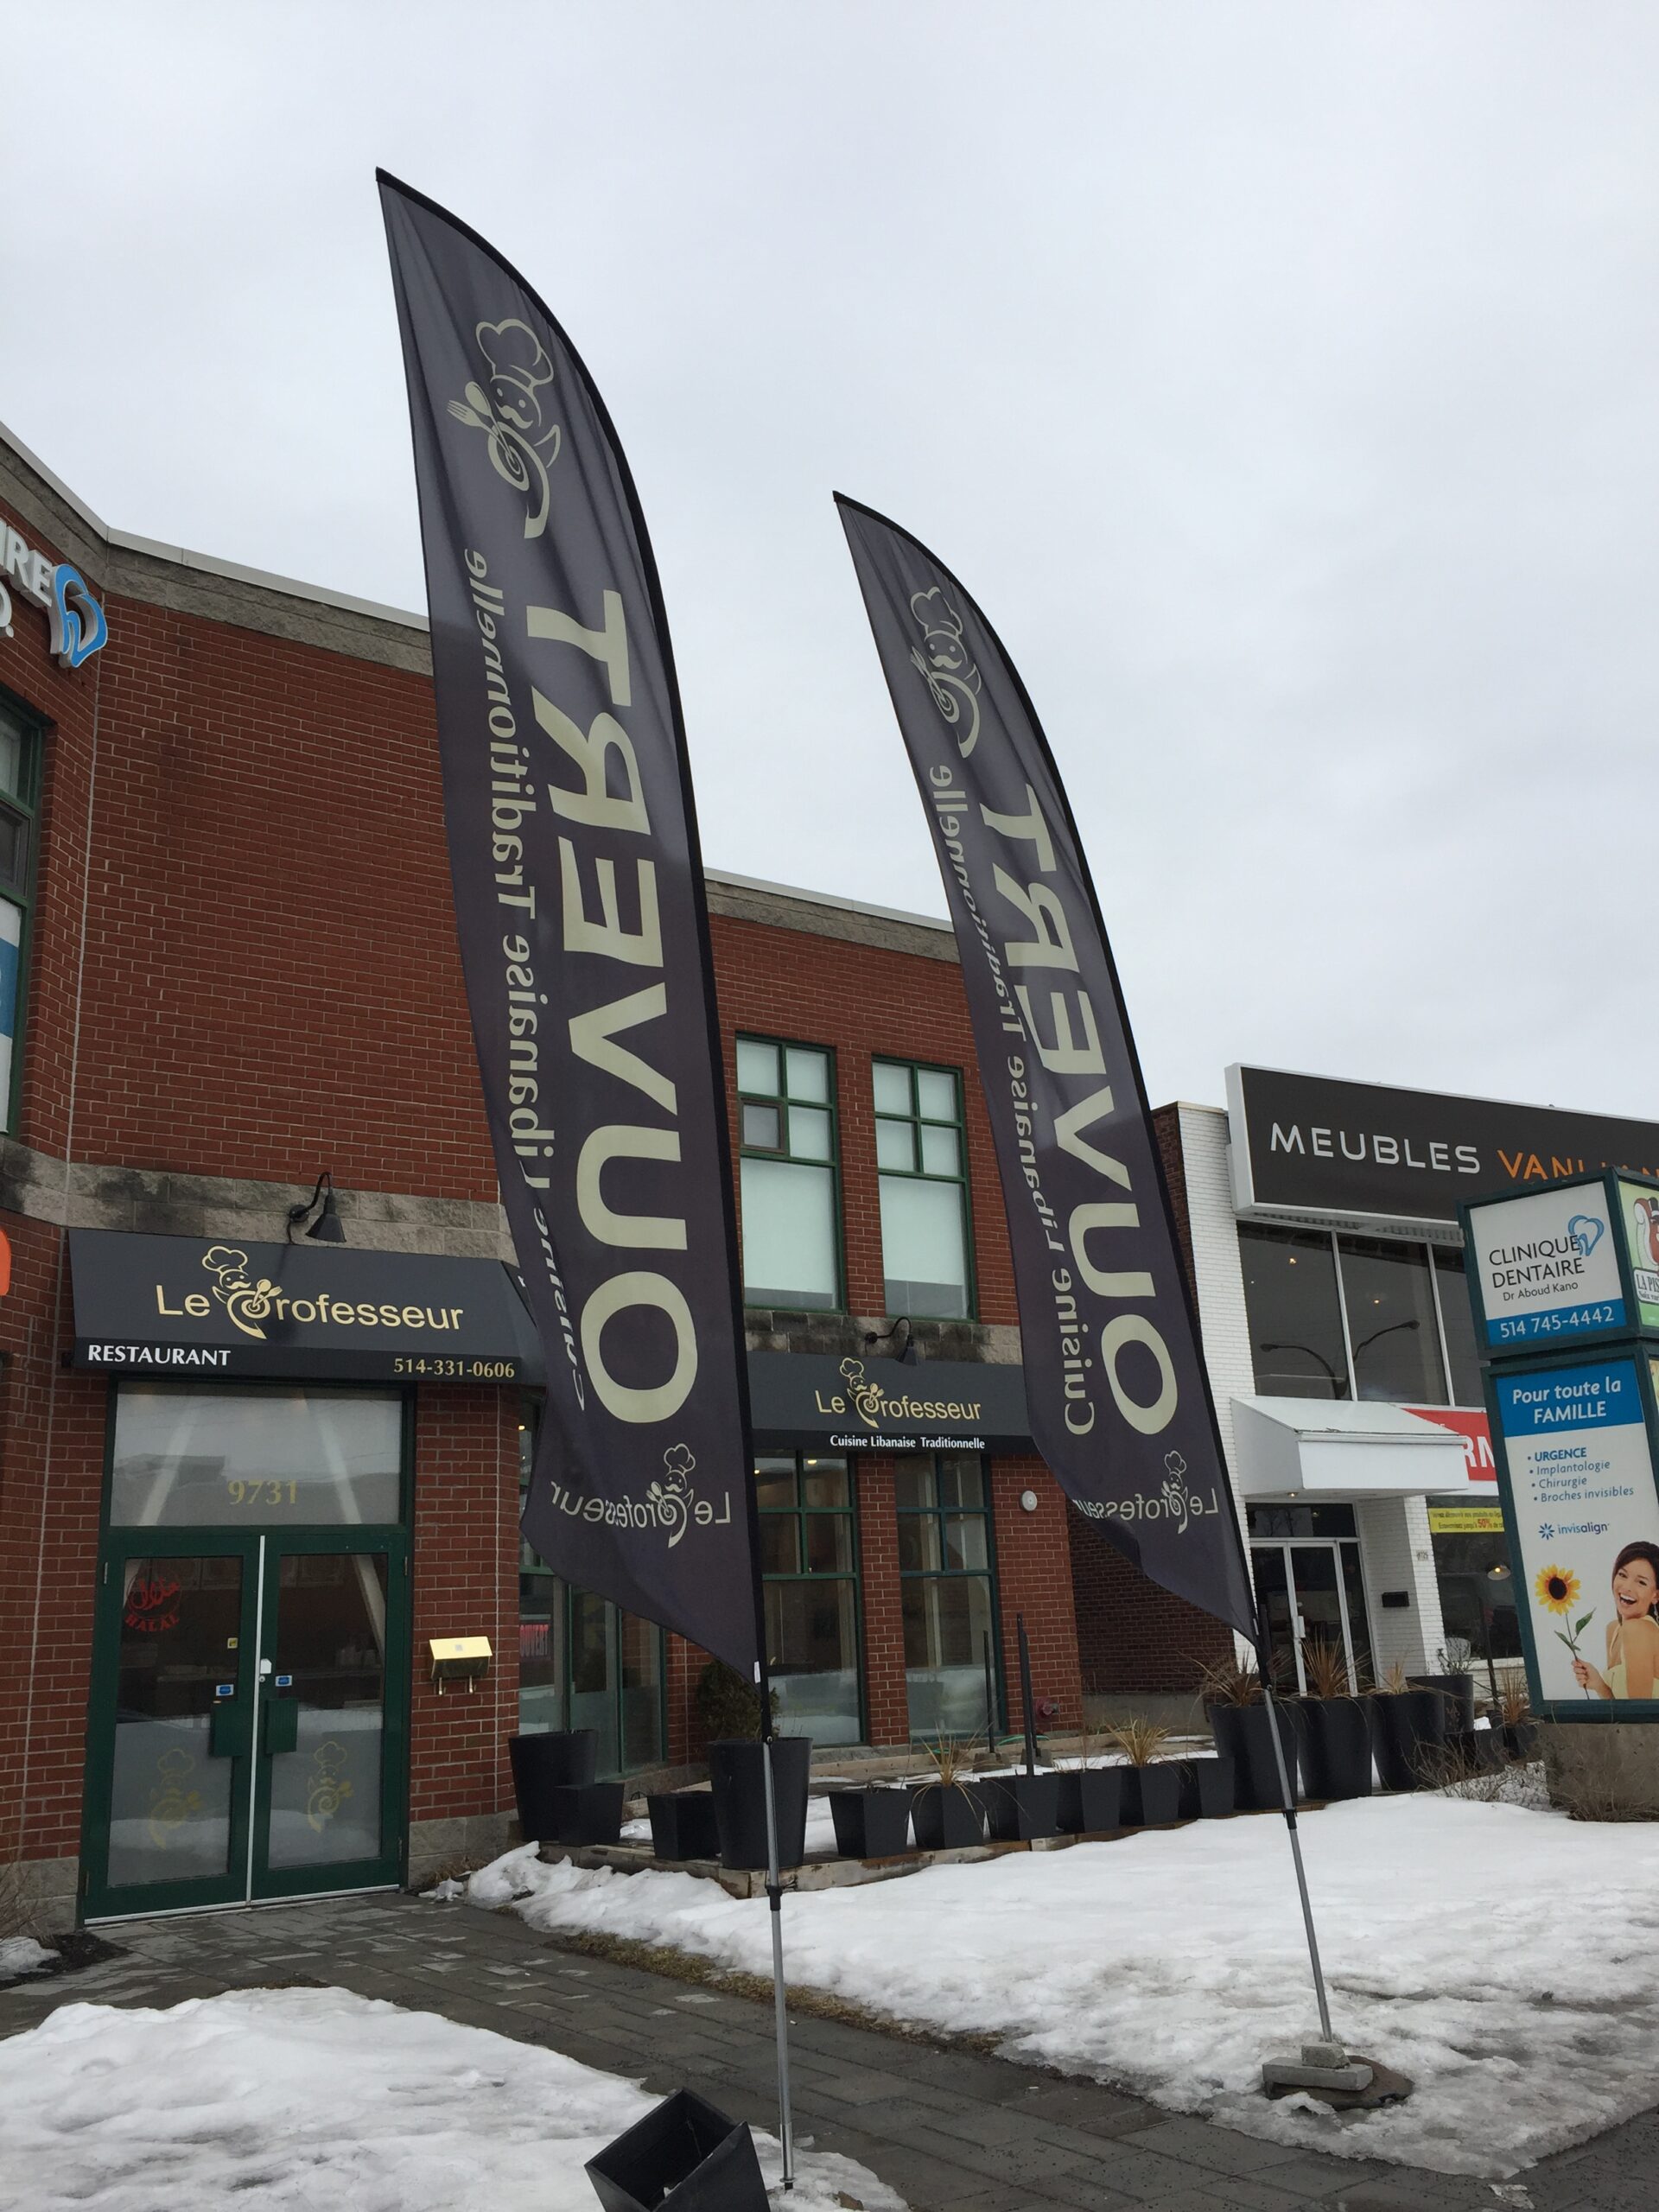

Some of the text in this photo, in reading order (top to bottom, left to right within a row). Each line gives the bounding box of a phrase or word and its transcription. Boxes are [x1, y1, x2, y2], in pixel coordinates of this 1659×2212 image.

[1270, 1122, 1480, 1174] MEUBLES
[1490, 1235, 1580, 1266] CLINIQUE
[1492, 1257, 1585, 1288] DENTAIRE
[156, 1285, 210, 1318] Le
[1503, 1281, 1578, 1301] Dr Aboud Kano
[1500, 1306, 1614, 1338] 514 745-4442
[87, 1344, 231, 1367] RESTAURANT
[393, 1357, 515, 1379] 514-331-0606
[1513, 1376, 1621, 1404] Pour toute la
[815, 1390, 846, 1414] Le
[1535, 1401, 1606, 1424] FAMILLE
[830, 1435, 985, 1449] Cuisine Libanaise Traditionnelle
[1535, 1447, 1586, 1461] URGENCE
[1537, 1460, 1610, 1476] Implantologie
[227, 1478, 298, 1506] 9731
[1539, 1476, 1587, 1489] Chirurgie
[1541, 1485, 1634, 1502] Broches invisibles
[1558, 1522, 1608, 1535] invisalign
